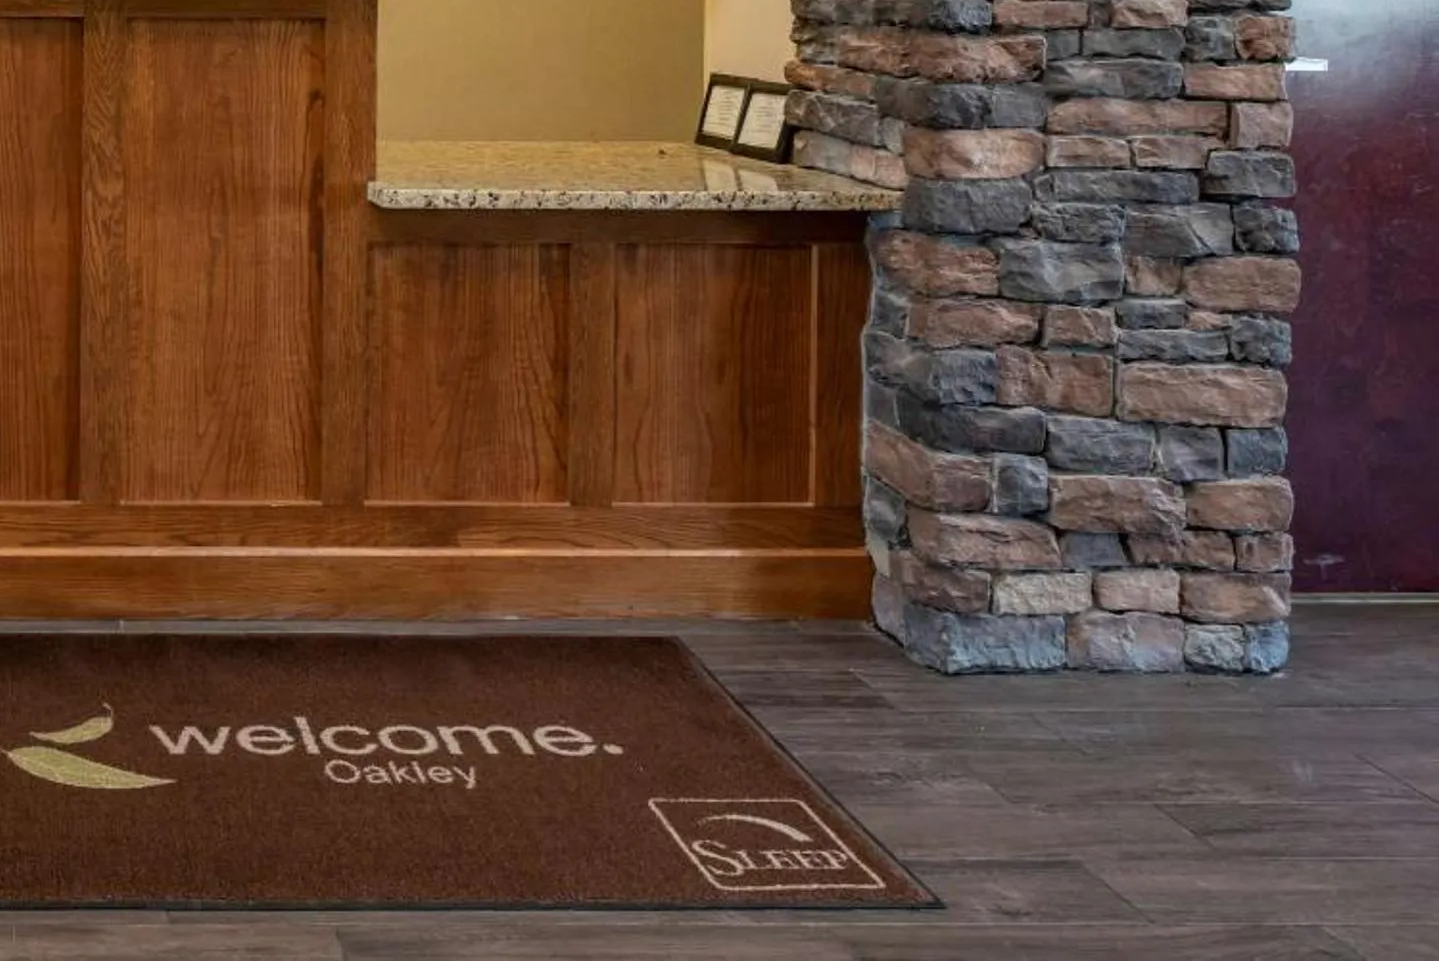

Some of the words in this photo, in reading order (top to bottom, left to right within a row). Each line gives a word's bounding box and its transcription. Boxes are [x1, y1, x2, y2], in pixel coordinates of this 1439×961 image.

[149, 716, 624, 756] welcome.
[323, 759, 477, 790] Oakley
[692, 840, 848, 877] SLEEP
